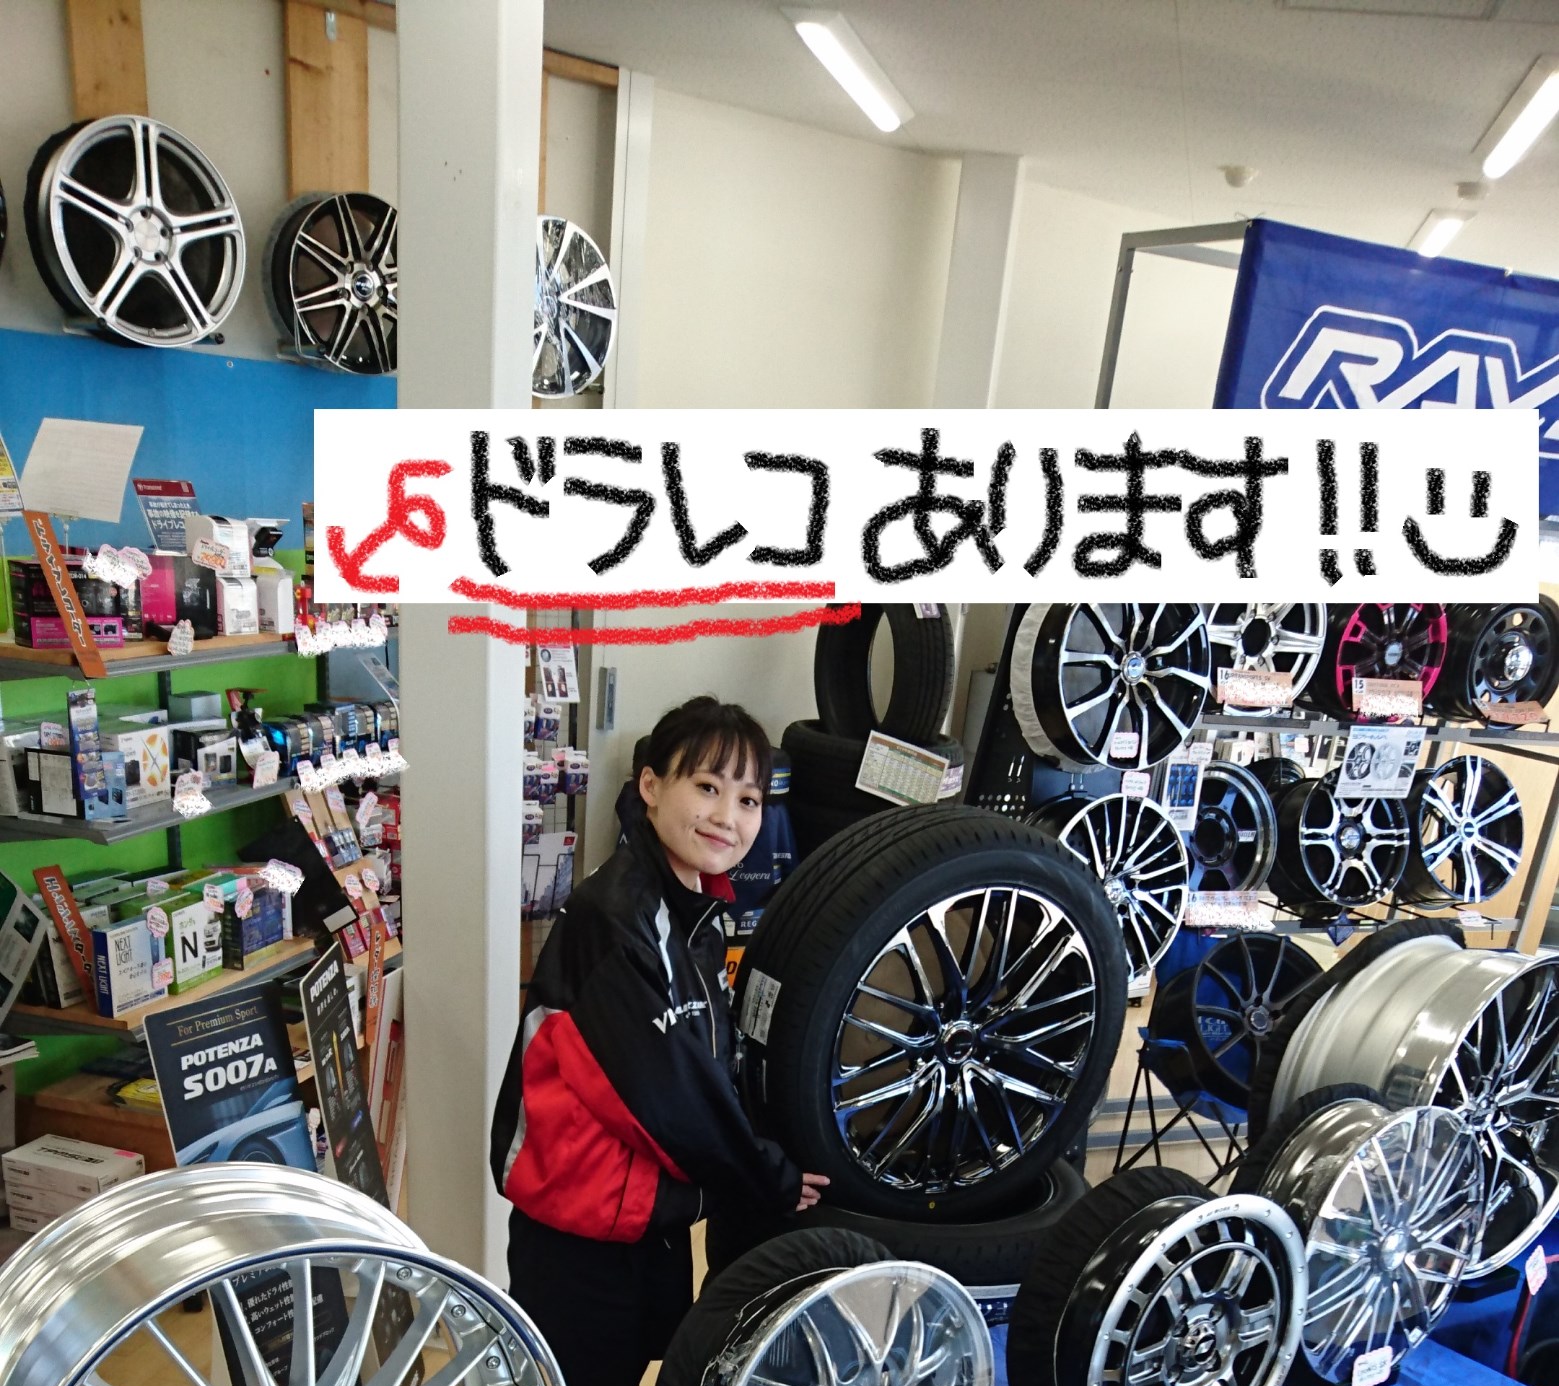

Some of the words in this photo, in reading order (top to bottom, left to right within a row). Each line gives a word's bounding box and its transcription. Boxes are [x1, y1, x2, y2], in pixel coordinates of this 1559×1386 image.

[151, 519, 187, 530] ドライブレコ
[32, 517, 87, 647] ドライブレコーダー
[114, 935, 131, 951] NEXT
[115, 949, 133, 966] LIGHT
[310, 959, 339, 1003] POTENZA
[177, 1024, 193, 1037] For
[195, 1014, 233, 1032] Premium
[234, 1005, 258, 1022] Sport
[181, 1033, 263, 1070] POTENZA
[183, 1053, 278, 1101] S007A
